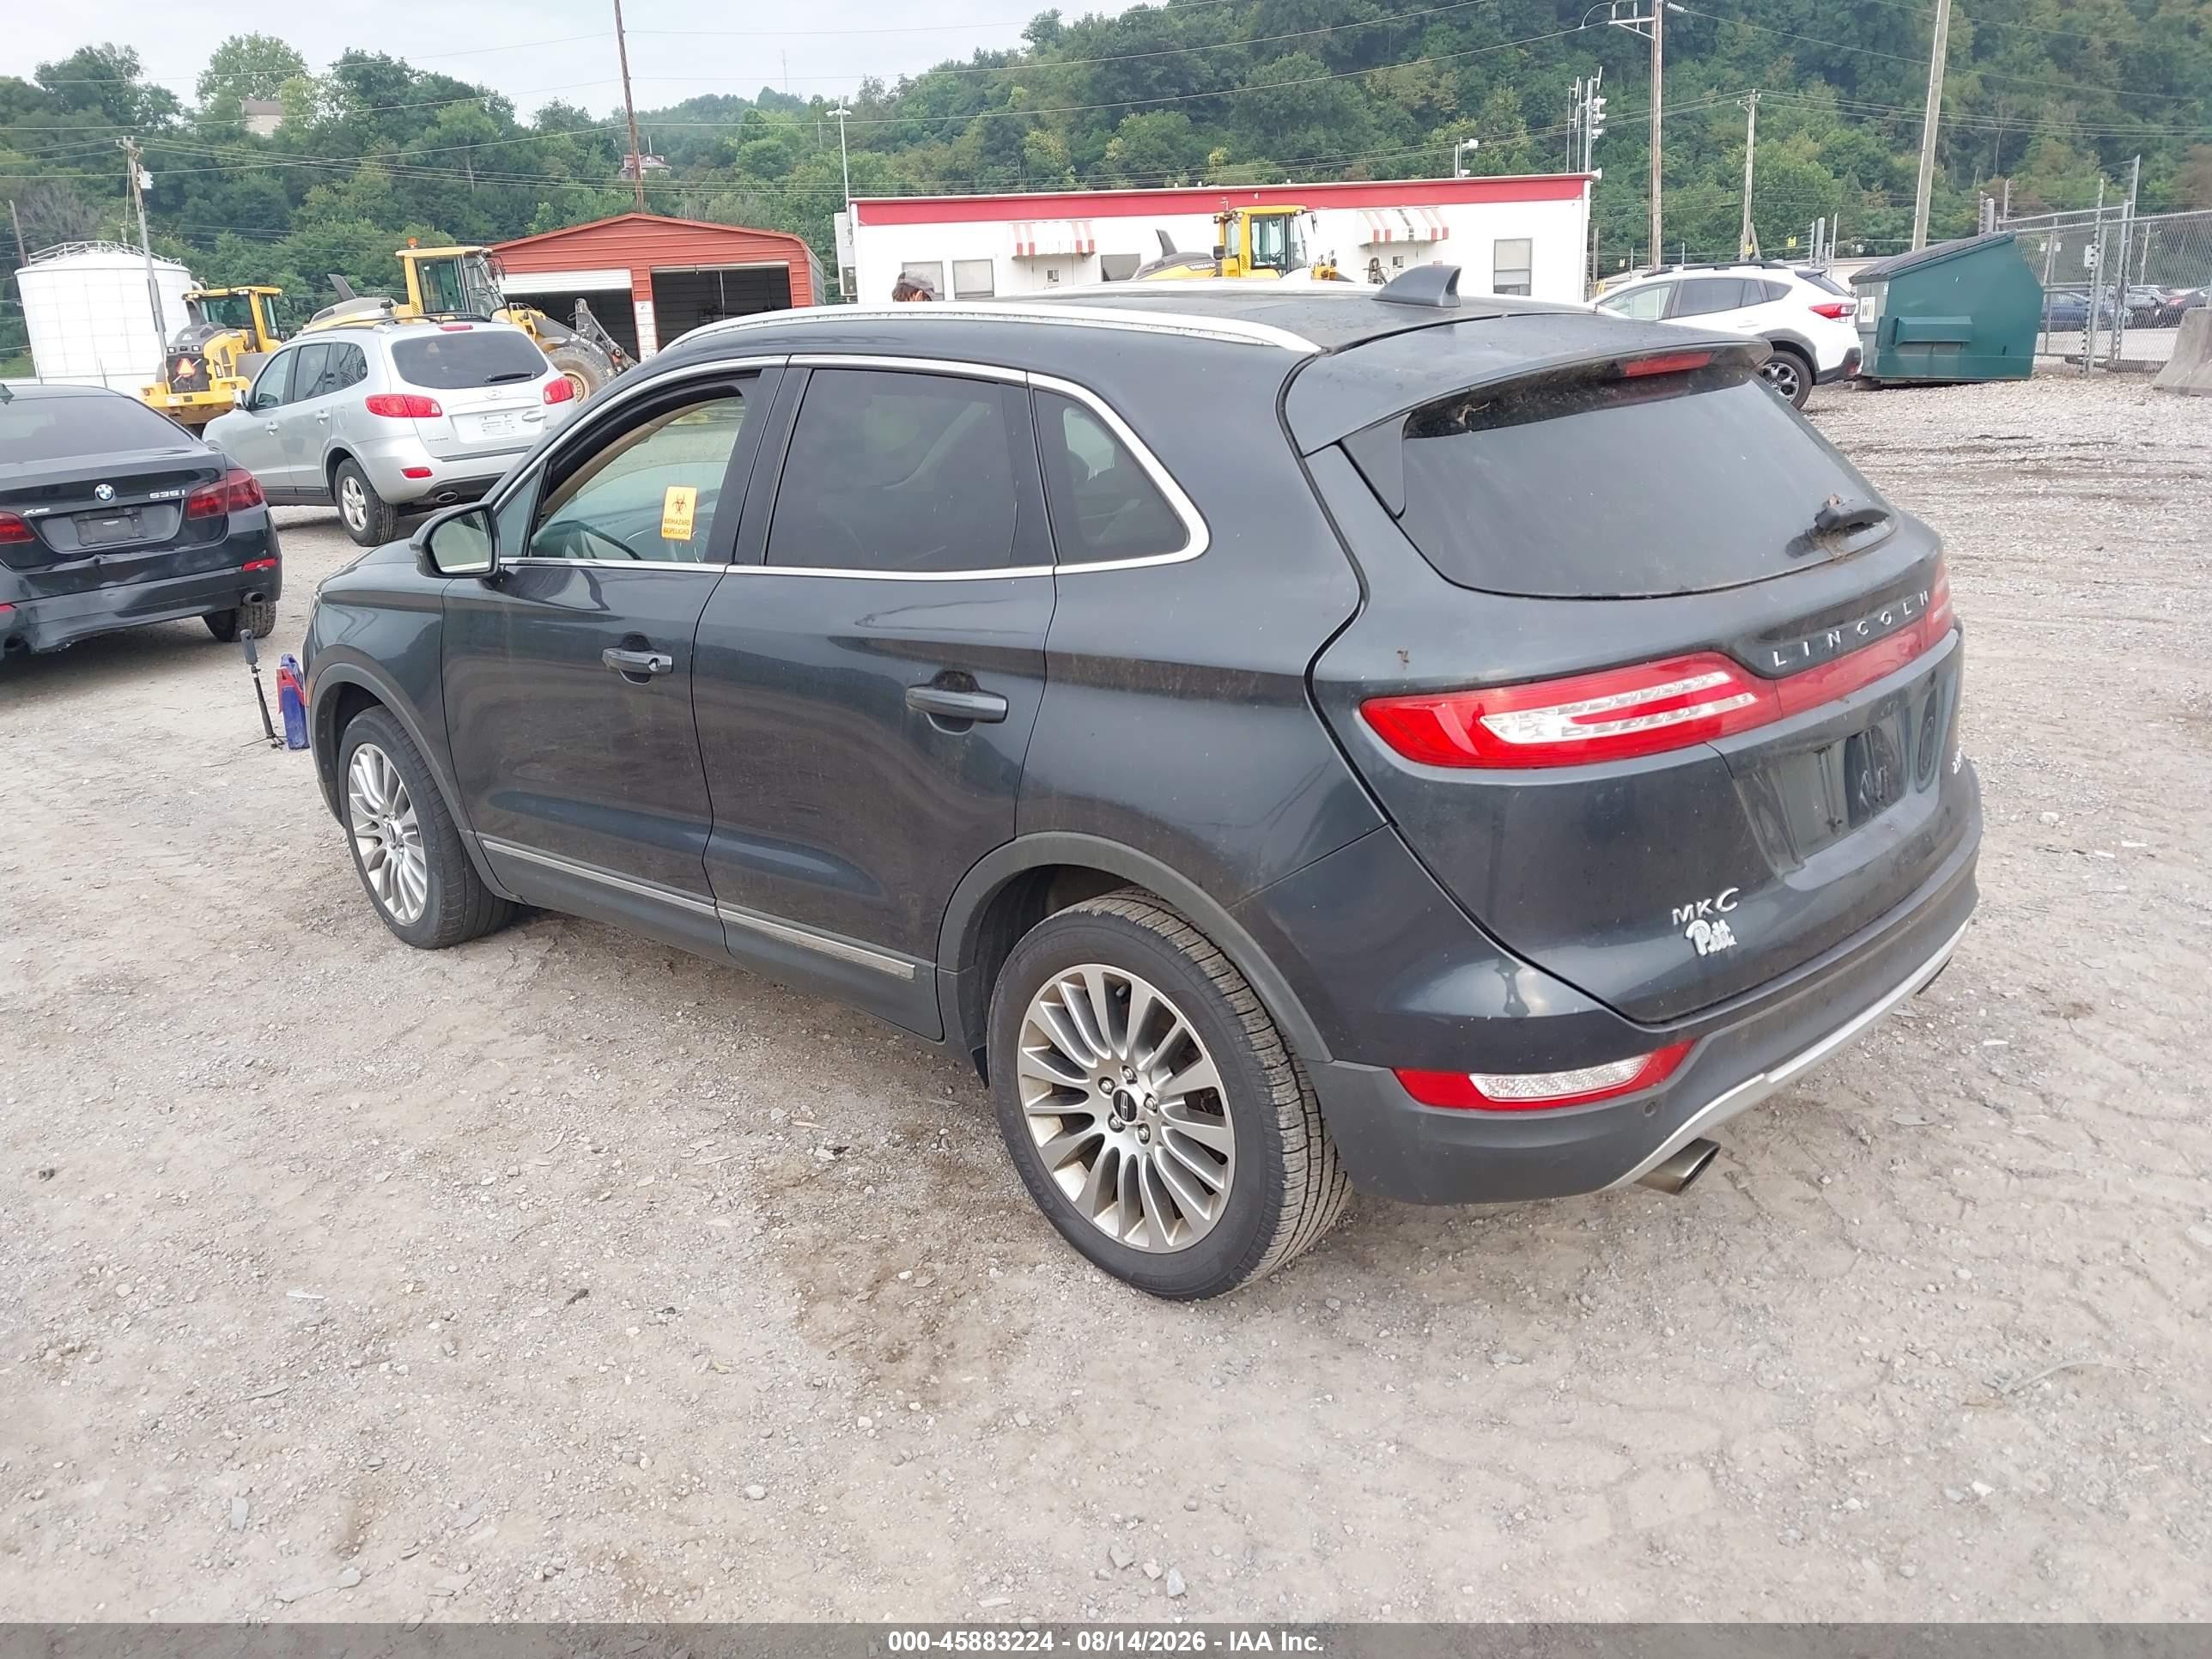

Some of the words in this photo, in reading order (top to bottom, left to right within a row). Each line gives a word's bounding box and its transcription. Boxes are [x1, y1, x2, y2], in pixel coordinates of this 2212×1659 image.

[580, 337, 592, 345] NOT
[1772, 590, 1929, 667] LINCOLN
[1671, 887, 1740, 926] MKC
